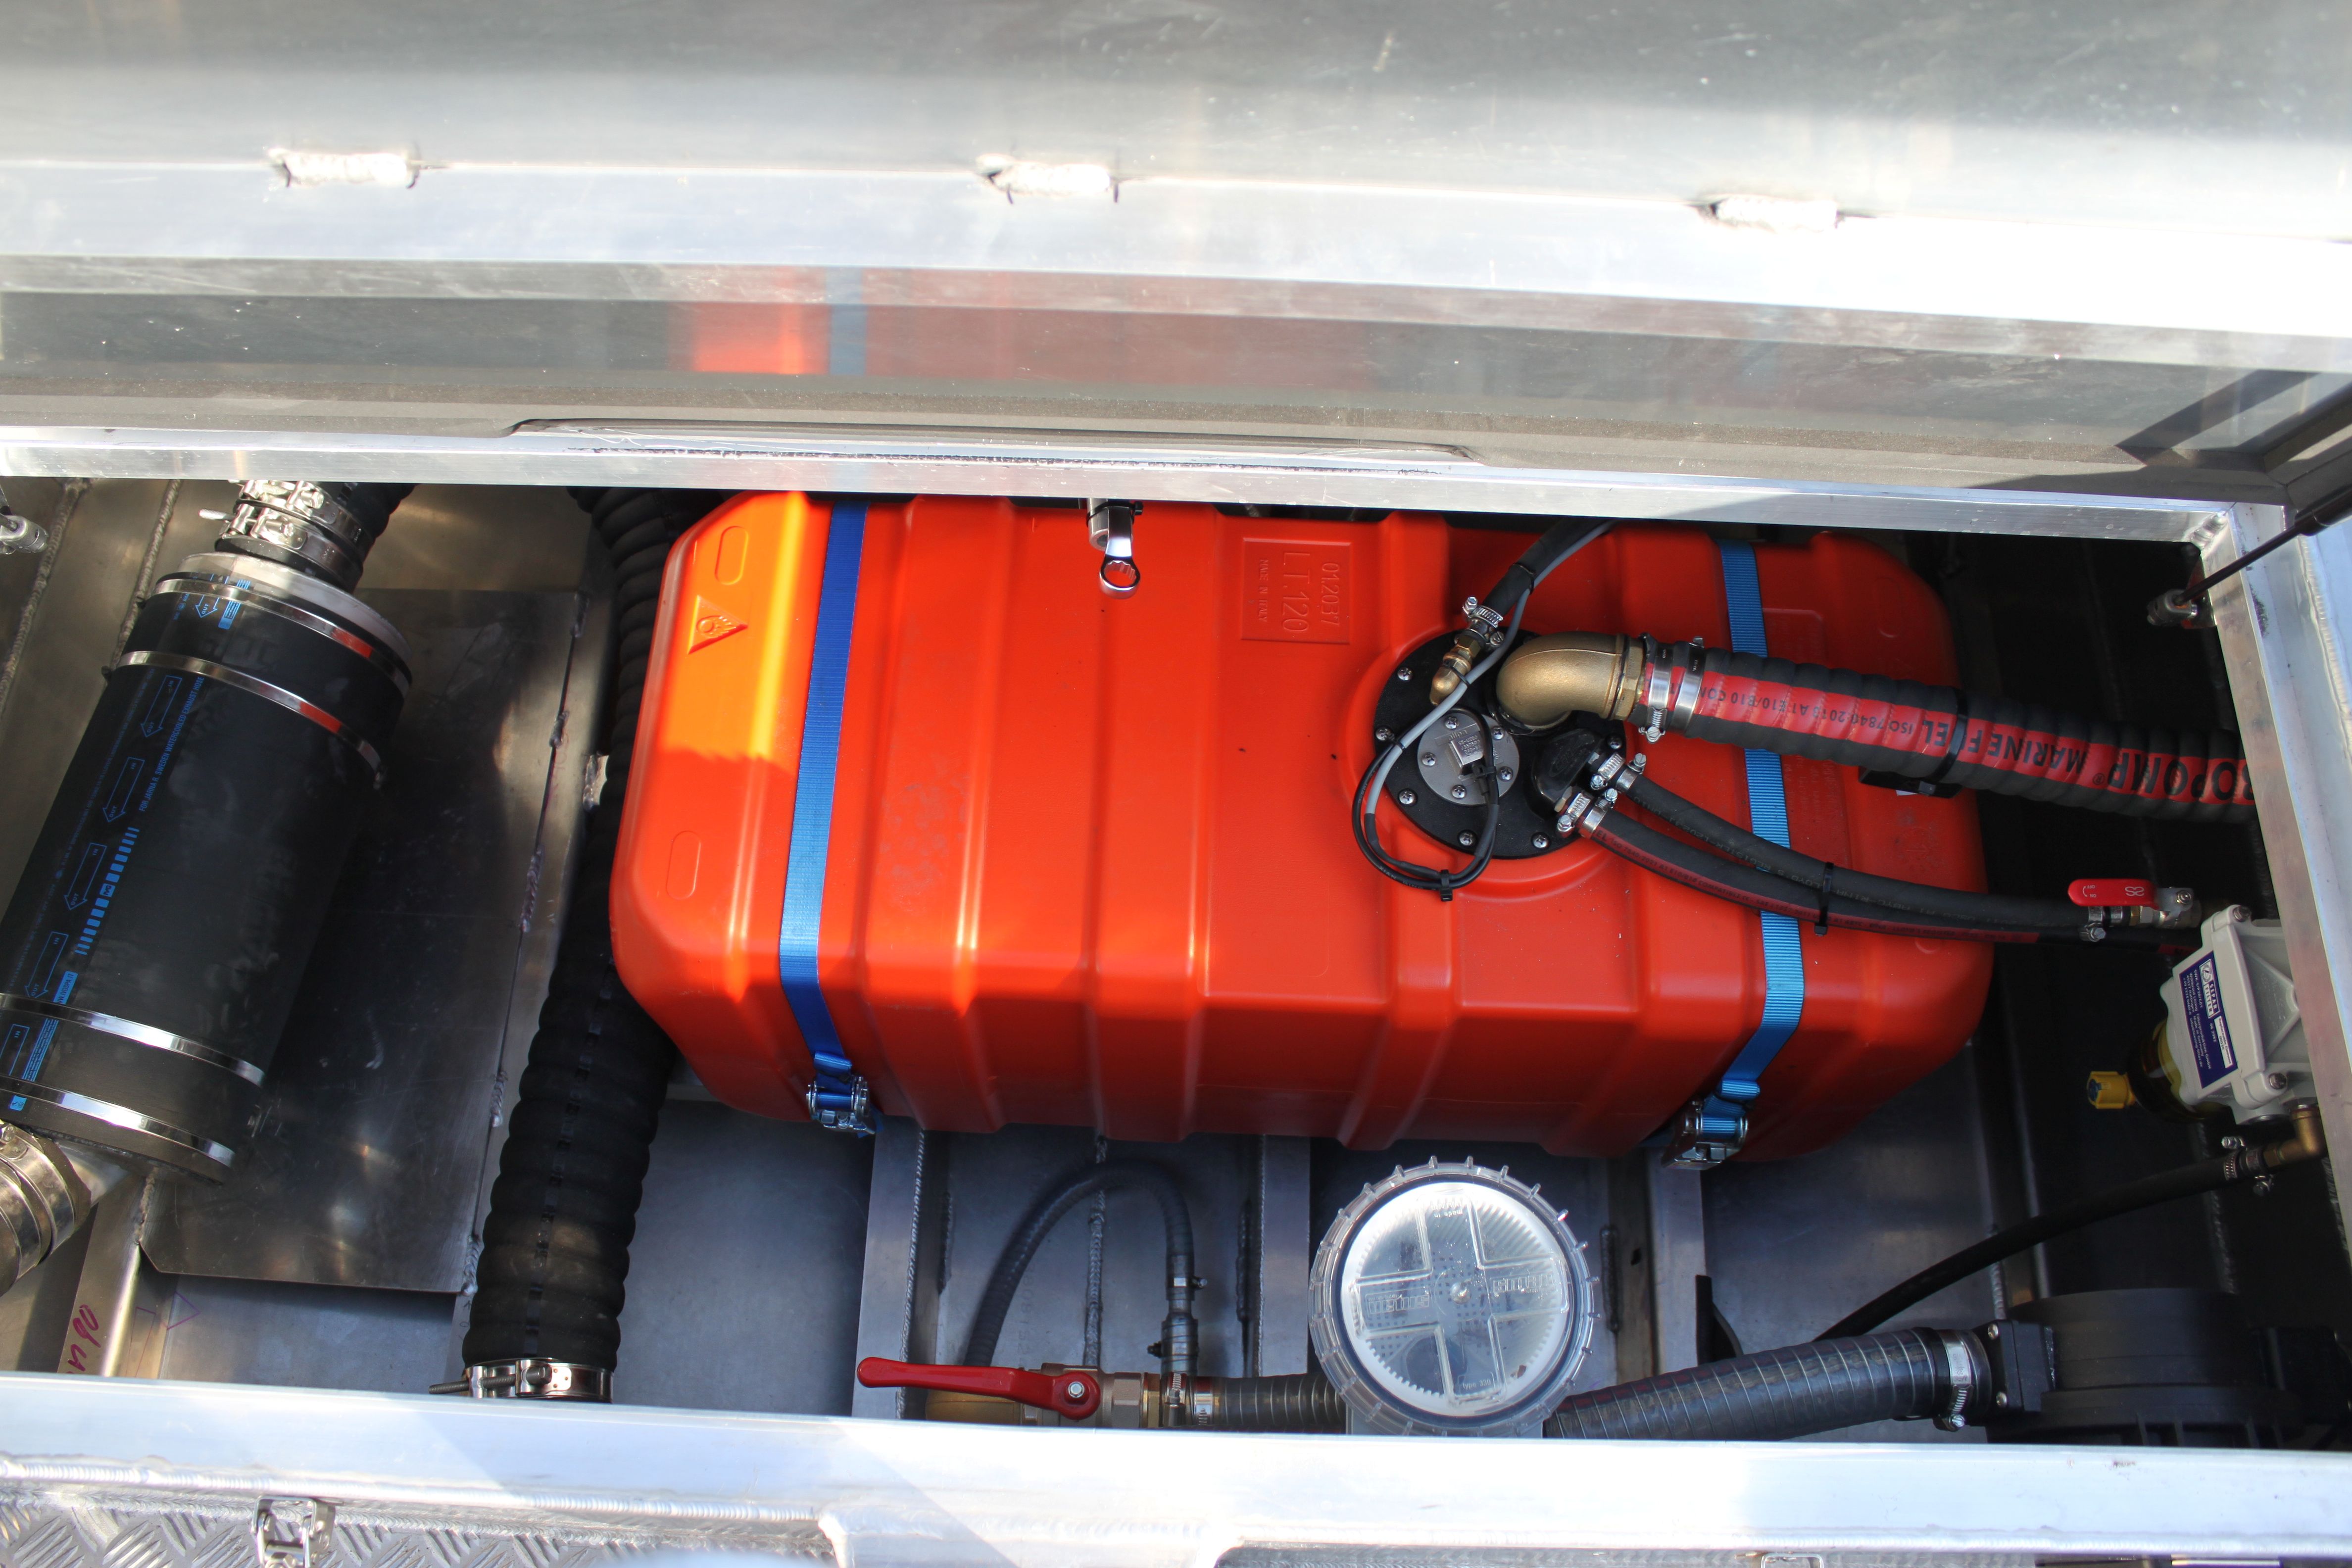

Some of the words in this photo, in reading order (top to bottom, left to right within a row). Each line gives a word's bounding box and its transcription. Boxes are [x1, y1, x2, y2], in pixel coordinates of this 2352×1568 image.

[1259, 558, 1268, 581] MADE
[1258, 599, 1267, 623] ITALY
[167, 679, 175, 688] IN
[192, 675, 204, 691] HOSE
[181, 689, 198, 715] EXHAUST
[146, 720, 155, 734] OUT
[164, 713, 187, 753] WATERCOOLED
[1890, 721, 1913, 735] ISO
[1924, 720, 1983, 752] FEL
[1989, 733, 2088, 774] MARINE
[129, 761, 137, 770] IN
[154, 751, 170, 776] SWEDEN
[143, 781, 158, 800] JARNA
[108, 804, 118, 819] OUT
[138, 799, 150, 812] FOR
[91, 847, 99, 856] IN
[70, 892, 79, 906] OUT
[52, 936, 60, 945] IN
[30, 982, 39, 997] OUT
[2208, 982, 2218, 1011] SEPAR
[2204, 985, 2213, 1014] FILTER
[13, 1029, 21, 1039] IN
